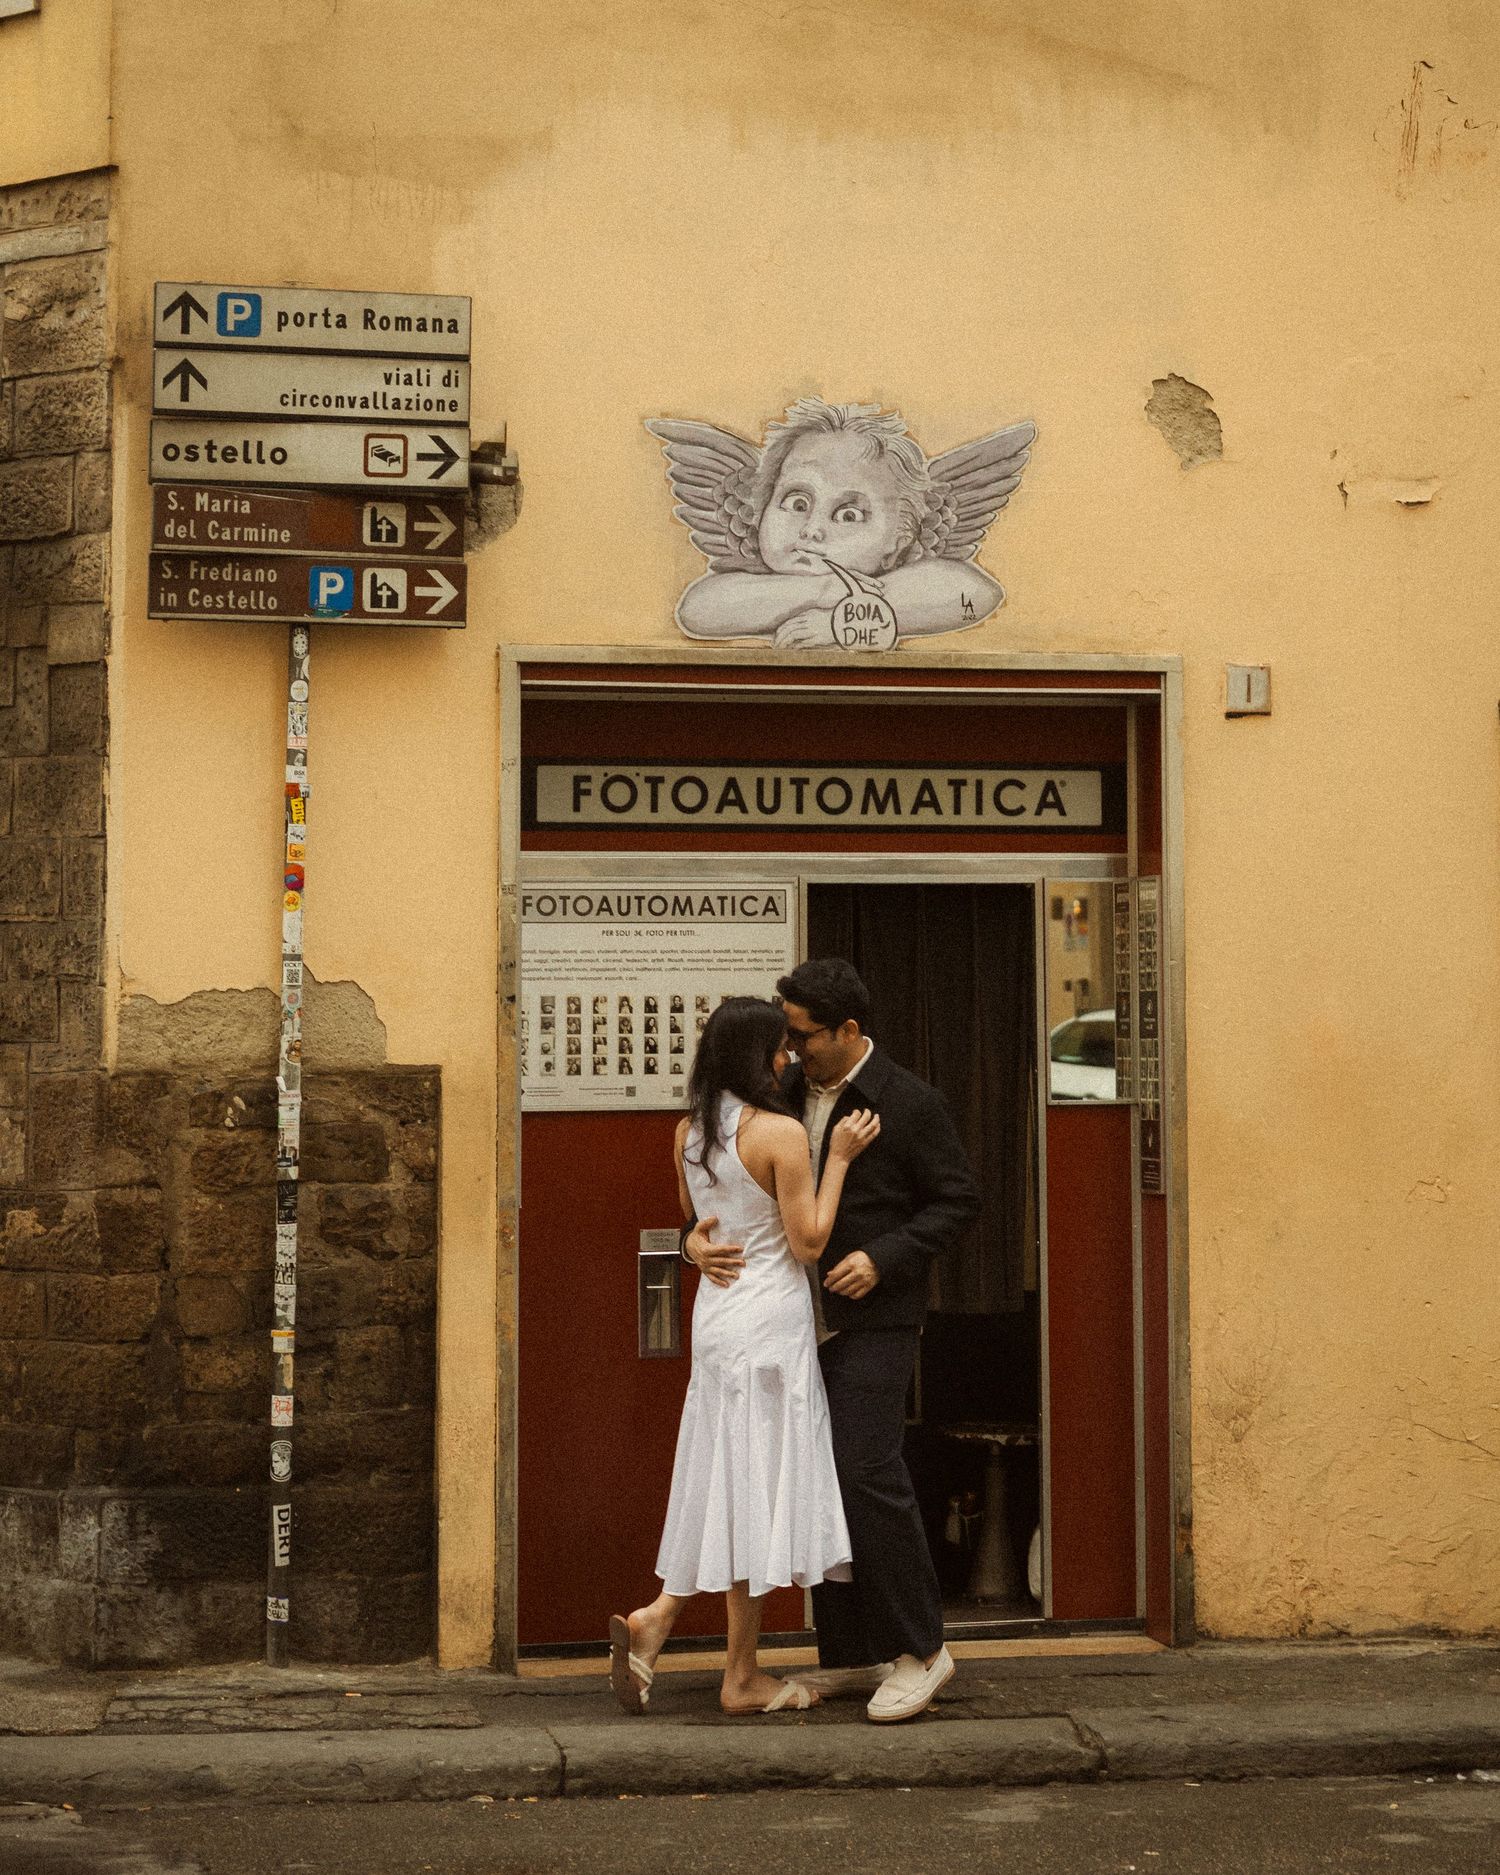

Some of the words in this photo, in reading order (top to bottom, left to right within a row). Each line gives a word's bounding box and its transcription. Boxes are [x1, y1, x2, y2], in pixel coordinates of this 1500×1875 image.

[276, 307, 347, 332] porta
[363, 309, 459, 335] Romana
[383, 368, 431, 388] viali
[442, 370, 459, 388] di
[280, 389, 459, 413] circonvallazione
[162, 438, 288, 466] ostello
[167, 491, 184, 512] S.
[195, 493, 251, 515] Maria
[164, 519, 197, 540] del
[207, 521, 291, 543] Carmine
[162, 560, 179, 580] S.
[189, 561, 277, 583] Frediano
[159, 588, 178, 608] in
[188, 588, 278, 611] Cestello
[844, 603, 884, 624] BOIA
[573, 773, 1067, 817] FOTOAUTOMATICA
[522, 893, 780, 917] FOTOAUTOMATICA
[601, 929, 613, 937] PER
[616, 929, 631, 937] SOLI
[646, 929, 664, 937] FOTO
[666, 929, 678, 937] PER
